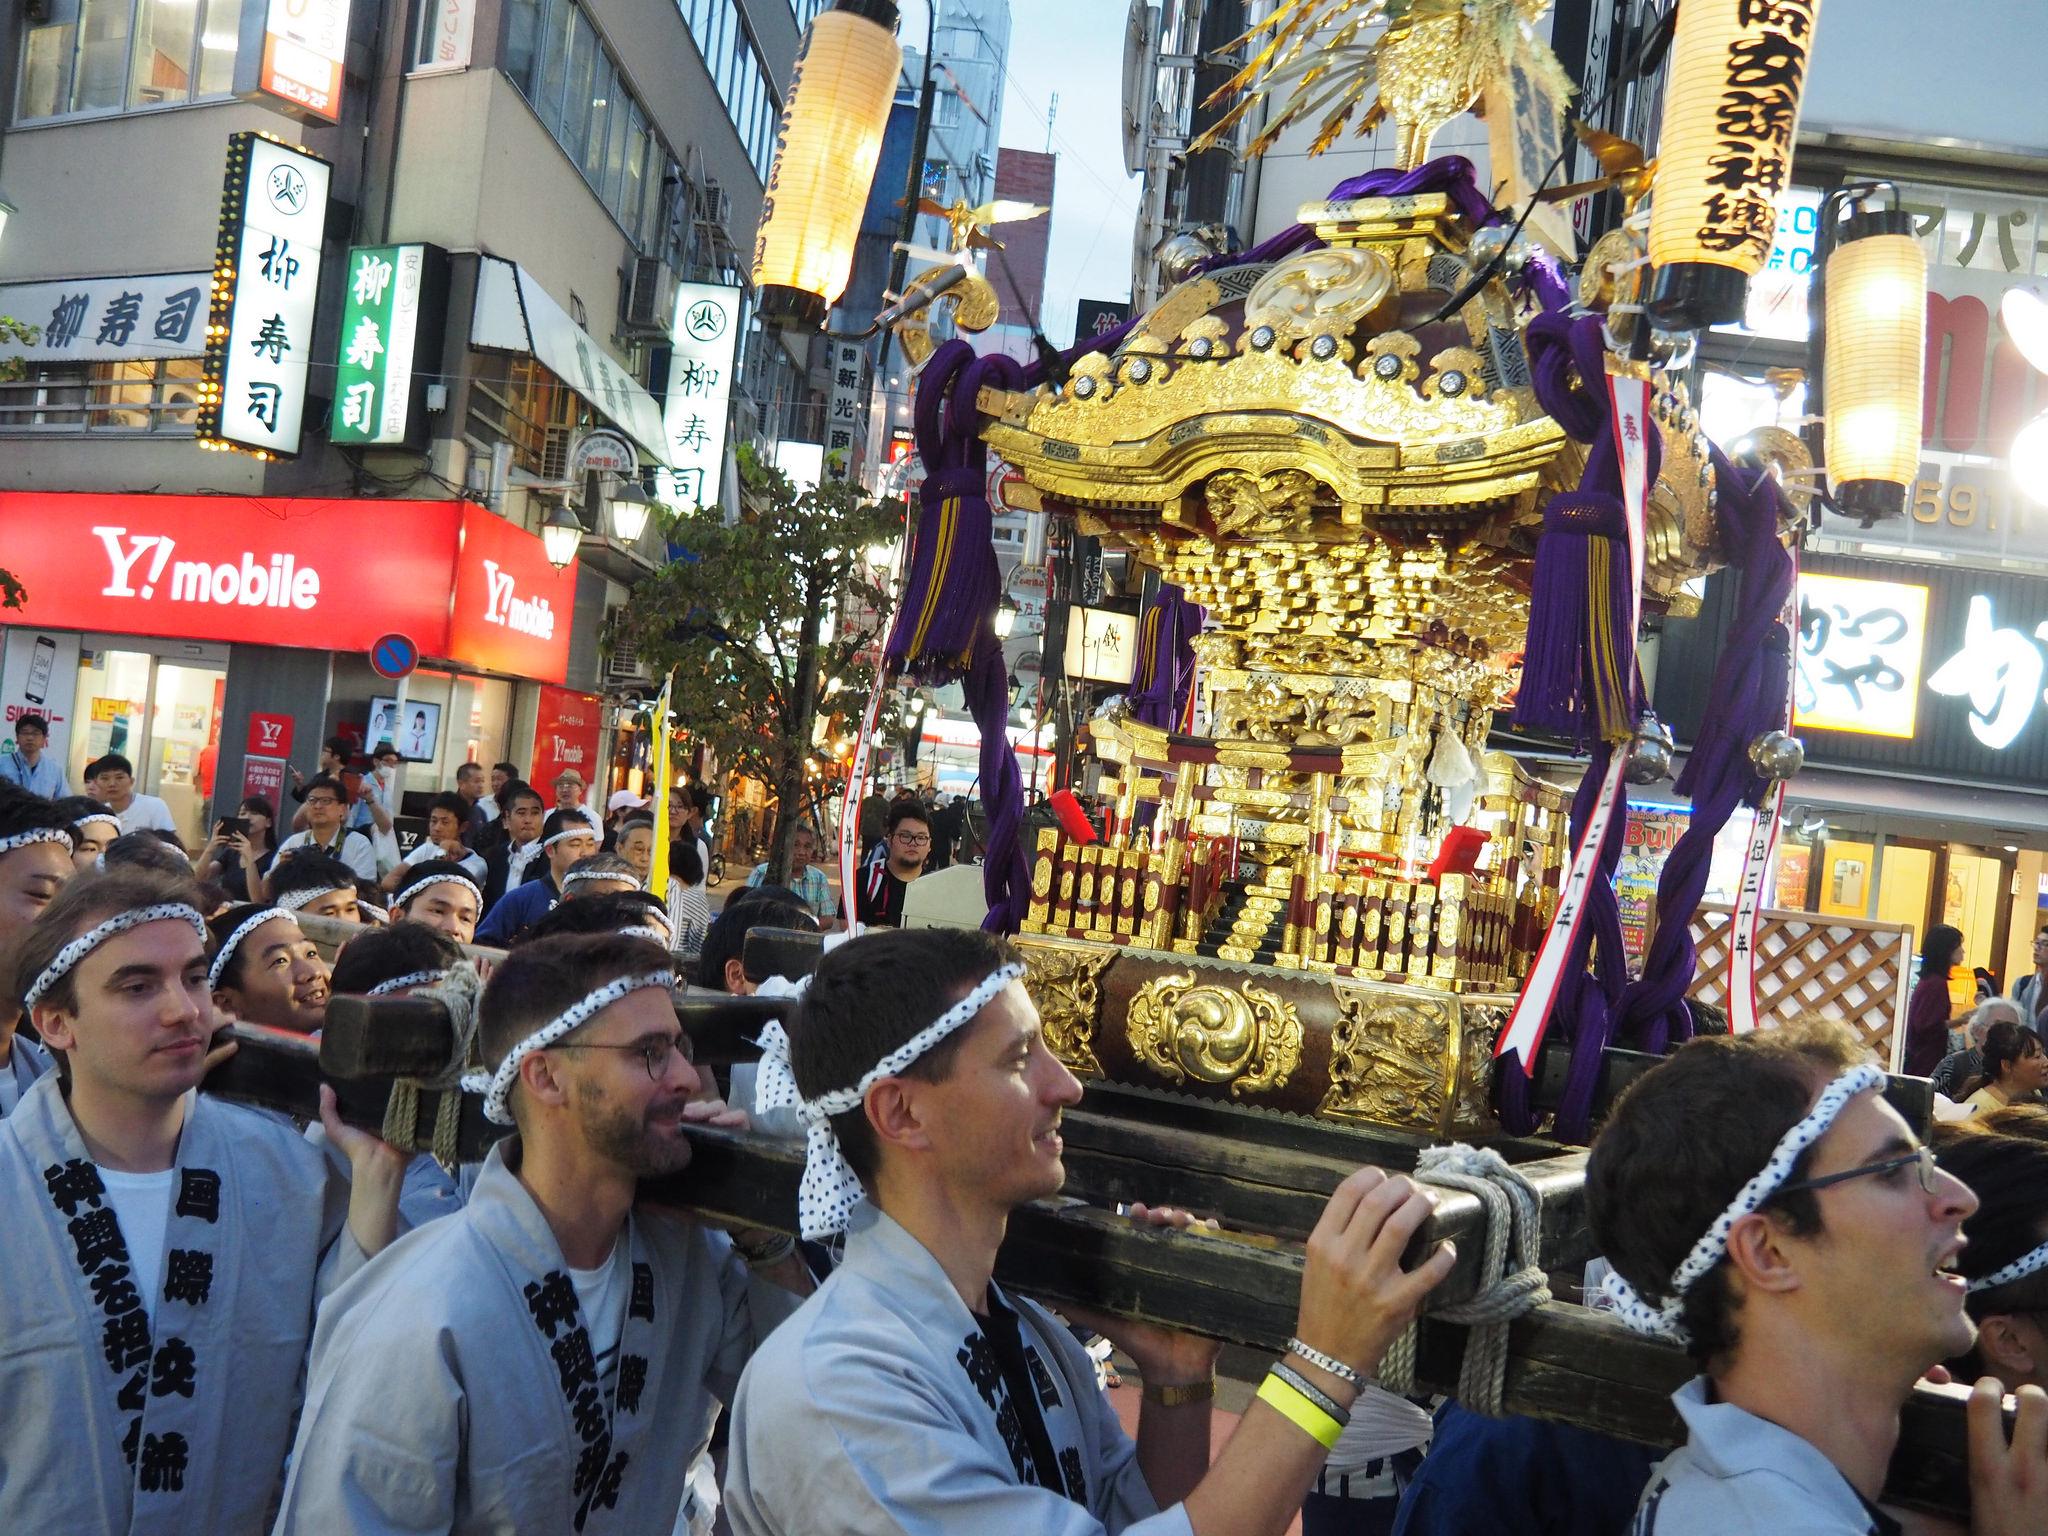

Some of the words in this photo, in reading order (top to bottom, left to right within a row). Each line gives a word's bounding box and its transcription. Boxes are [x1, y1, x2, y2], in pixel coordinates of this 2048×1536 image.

[45, 286, 204, 347] 柳寿司
[245, 234, 301, 434] 柳寿司
[341, 254, 393, 435] 柳寿司
[672, 359, 720, 510] 柳寿司
[92, 526, 320, 610] Y!mobile
[484, 560, 554, 641] Y!mobile
